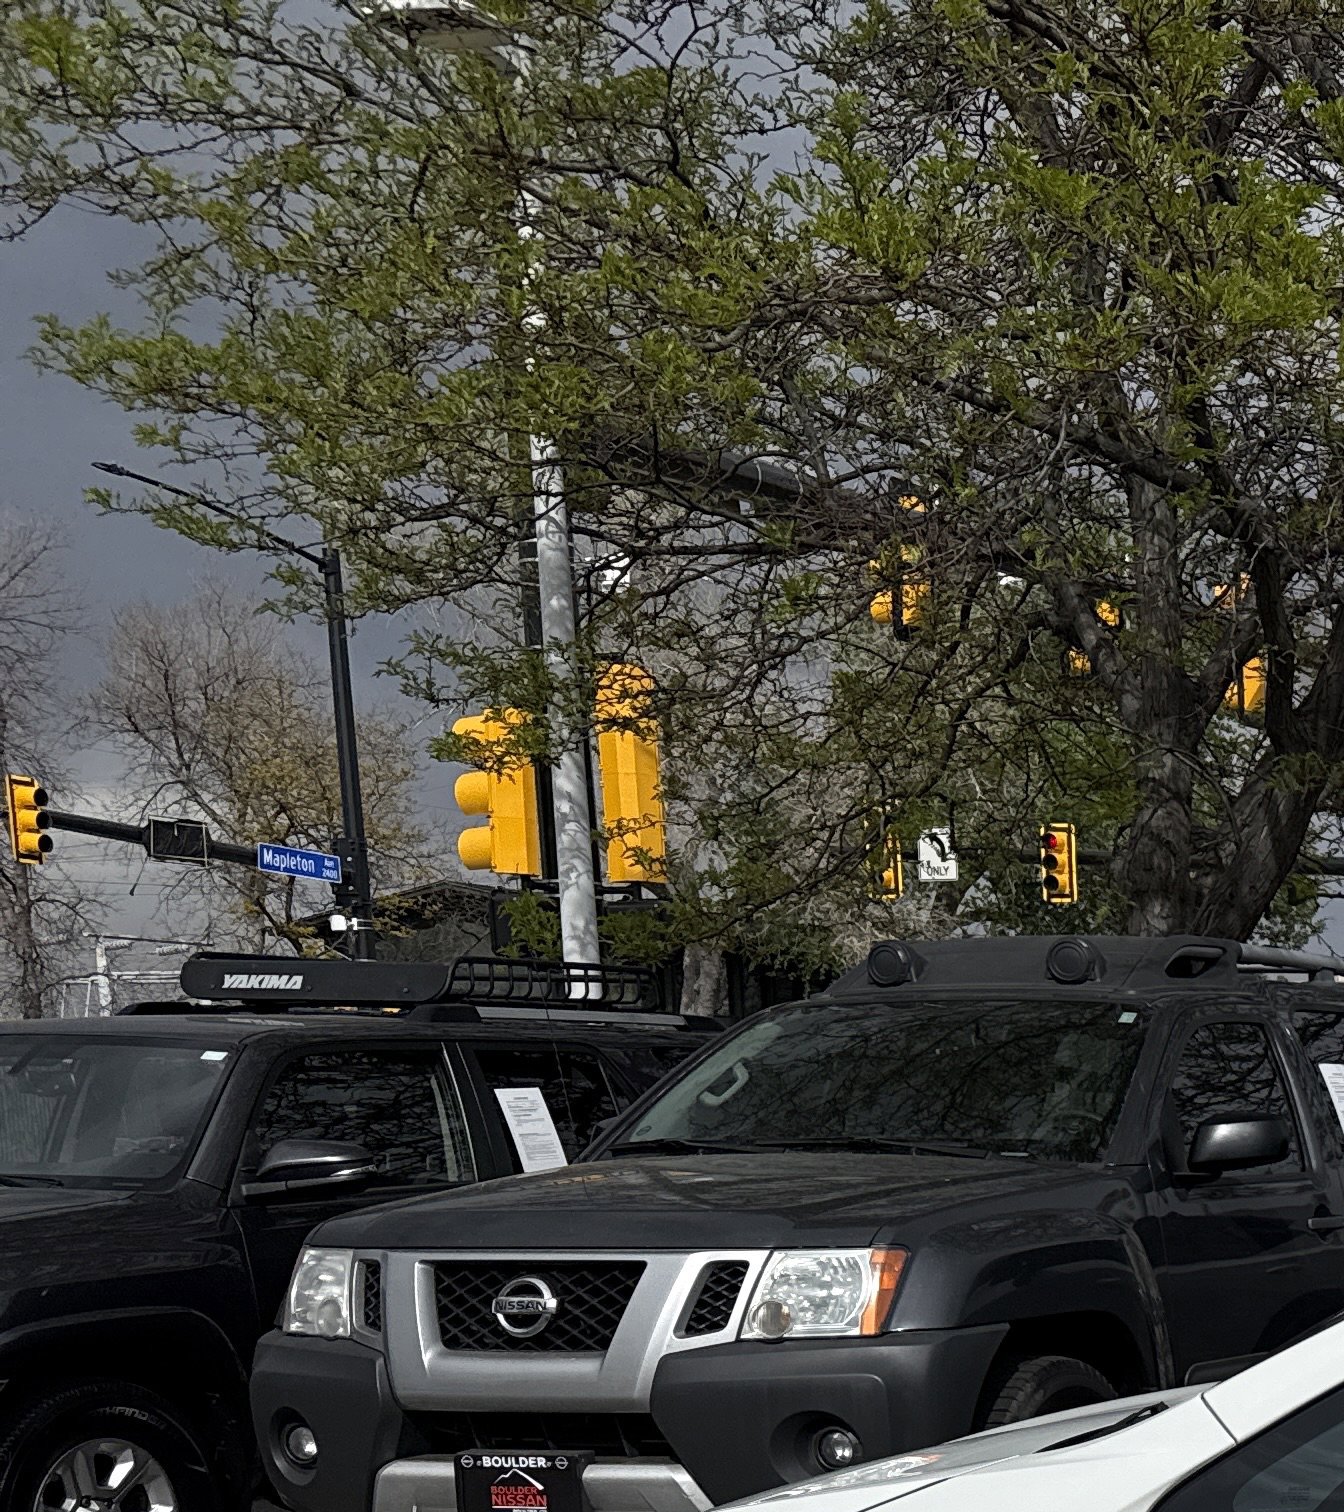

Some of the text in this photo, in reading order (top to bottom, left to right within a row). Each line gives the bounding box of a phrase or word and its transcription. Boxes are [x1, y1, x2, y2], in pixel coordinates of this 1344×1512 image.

[263, 847, 315, 874] Mapleton
[321, 868, 338, 879] 2400
[927, 865, 949, 876] ONLY
[222, 974, 304, 989] YAKIMA
[495, 1301, 547, 1311] NISSAN
[482, 1455, 547, 1468] BOULDER
[490, 1485, 539, 1495] BOULDER
[491, 1494, 547, 1507] NISSAN
